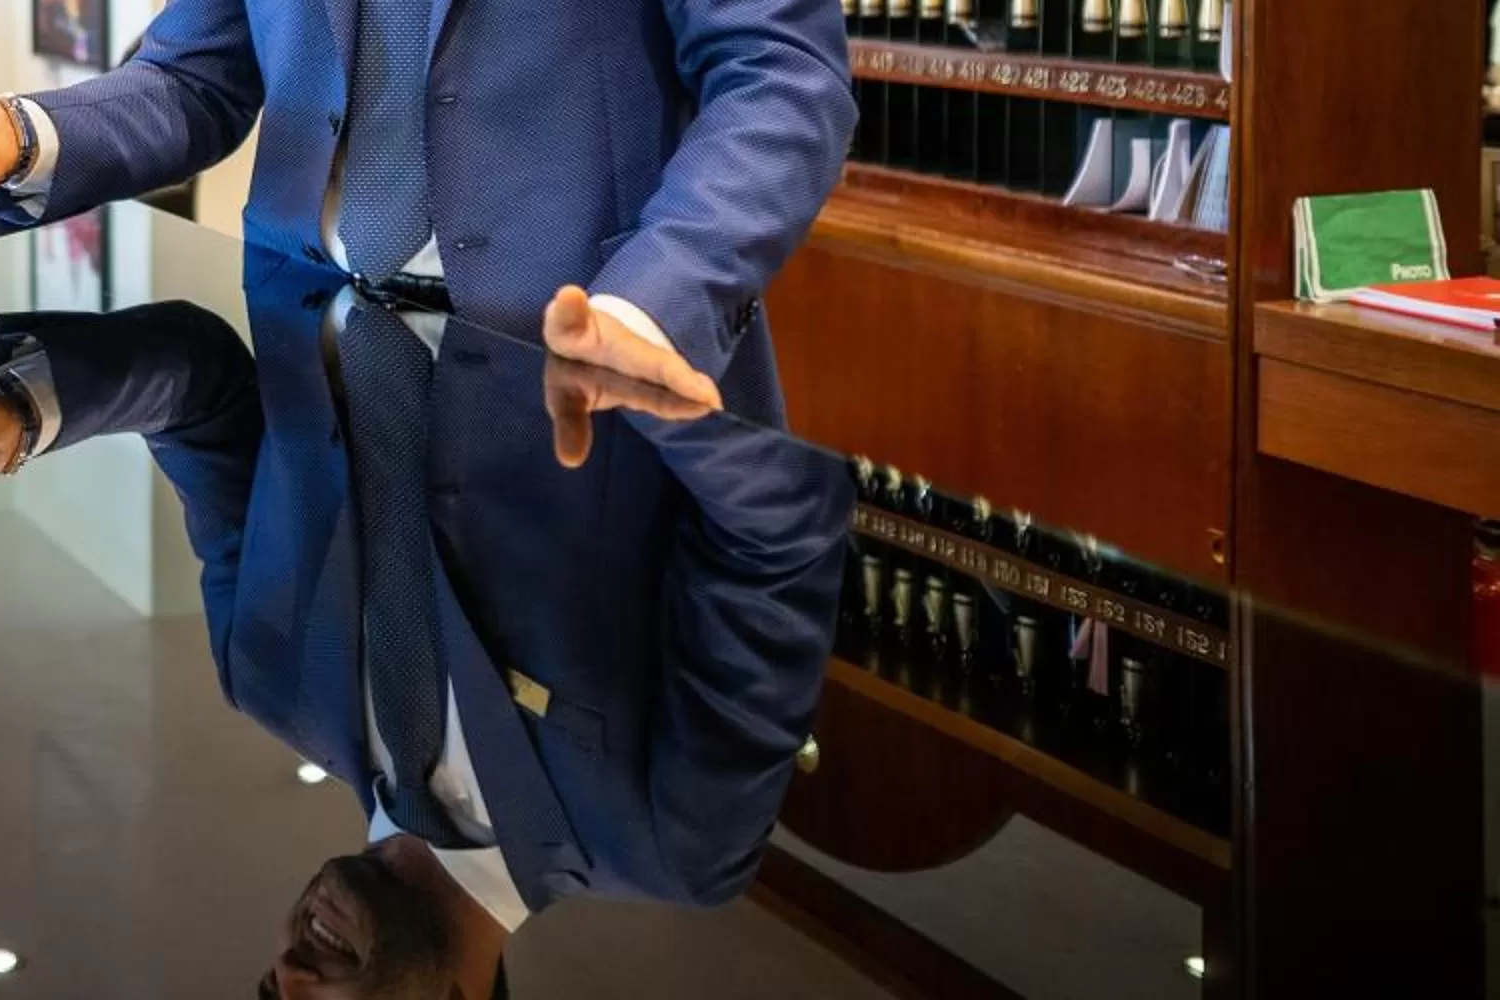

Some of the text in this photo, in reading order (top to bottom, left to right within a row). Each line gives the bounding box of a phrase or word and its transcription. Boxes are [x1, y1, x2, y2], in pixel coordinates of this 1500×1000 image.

[959, 60, 985, 82] 419
[992, 63, 1021, 86] 420
[1023, 66, 1049, 89] 421
[1059, 71, 1090, 92] 422
[1096, 75, 1127, 99] 423
[1135, 78, 1169, 104] 424
[1172, 82, 1206, 107] 425
